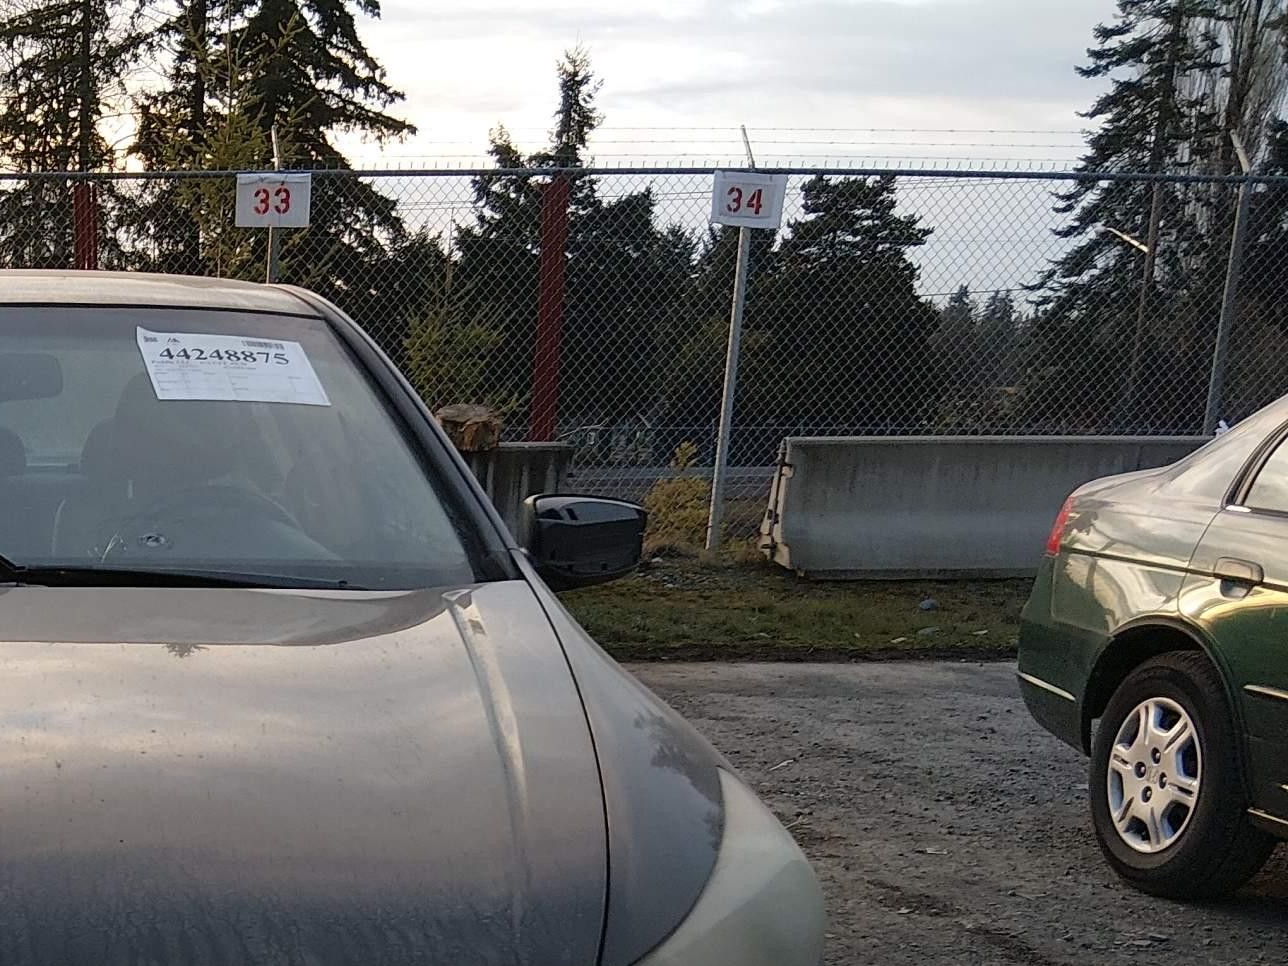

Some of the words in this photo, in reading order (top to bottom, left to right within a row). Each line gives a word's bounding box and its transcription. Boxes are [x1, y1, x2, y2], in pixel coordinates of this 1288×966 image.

[254, 187, 291, 215] 33
[726, 186, 763, 215] 34
[159, 347, 290, 366] 44248875
